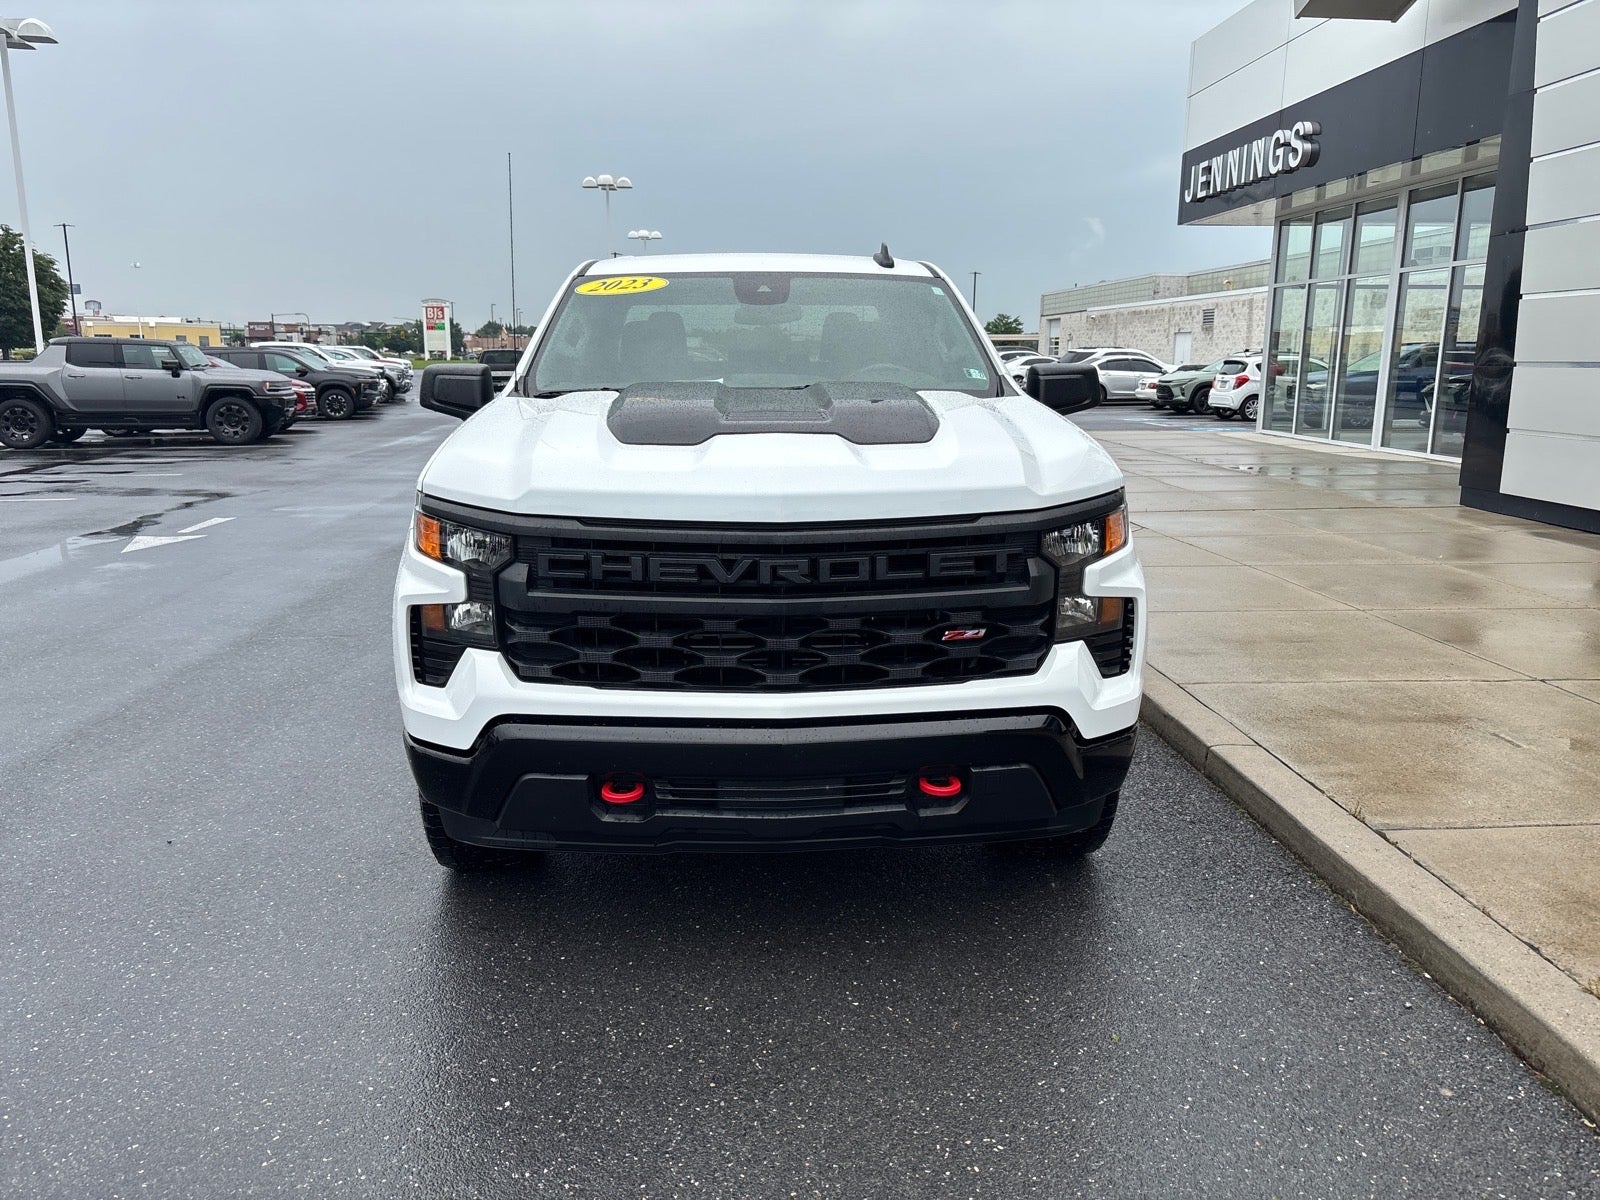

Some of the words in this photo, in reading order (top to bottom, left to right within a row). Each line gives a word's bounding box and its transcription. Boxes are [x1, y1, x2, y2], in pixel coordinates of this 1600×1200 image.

[1184, 121, 1312, 203] JENNINGS
[587, 278, 653, 293] 2023
[426, 307, 443, 321] BJ's
[537, 547, 1024, 585] CHEVROLET
